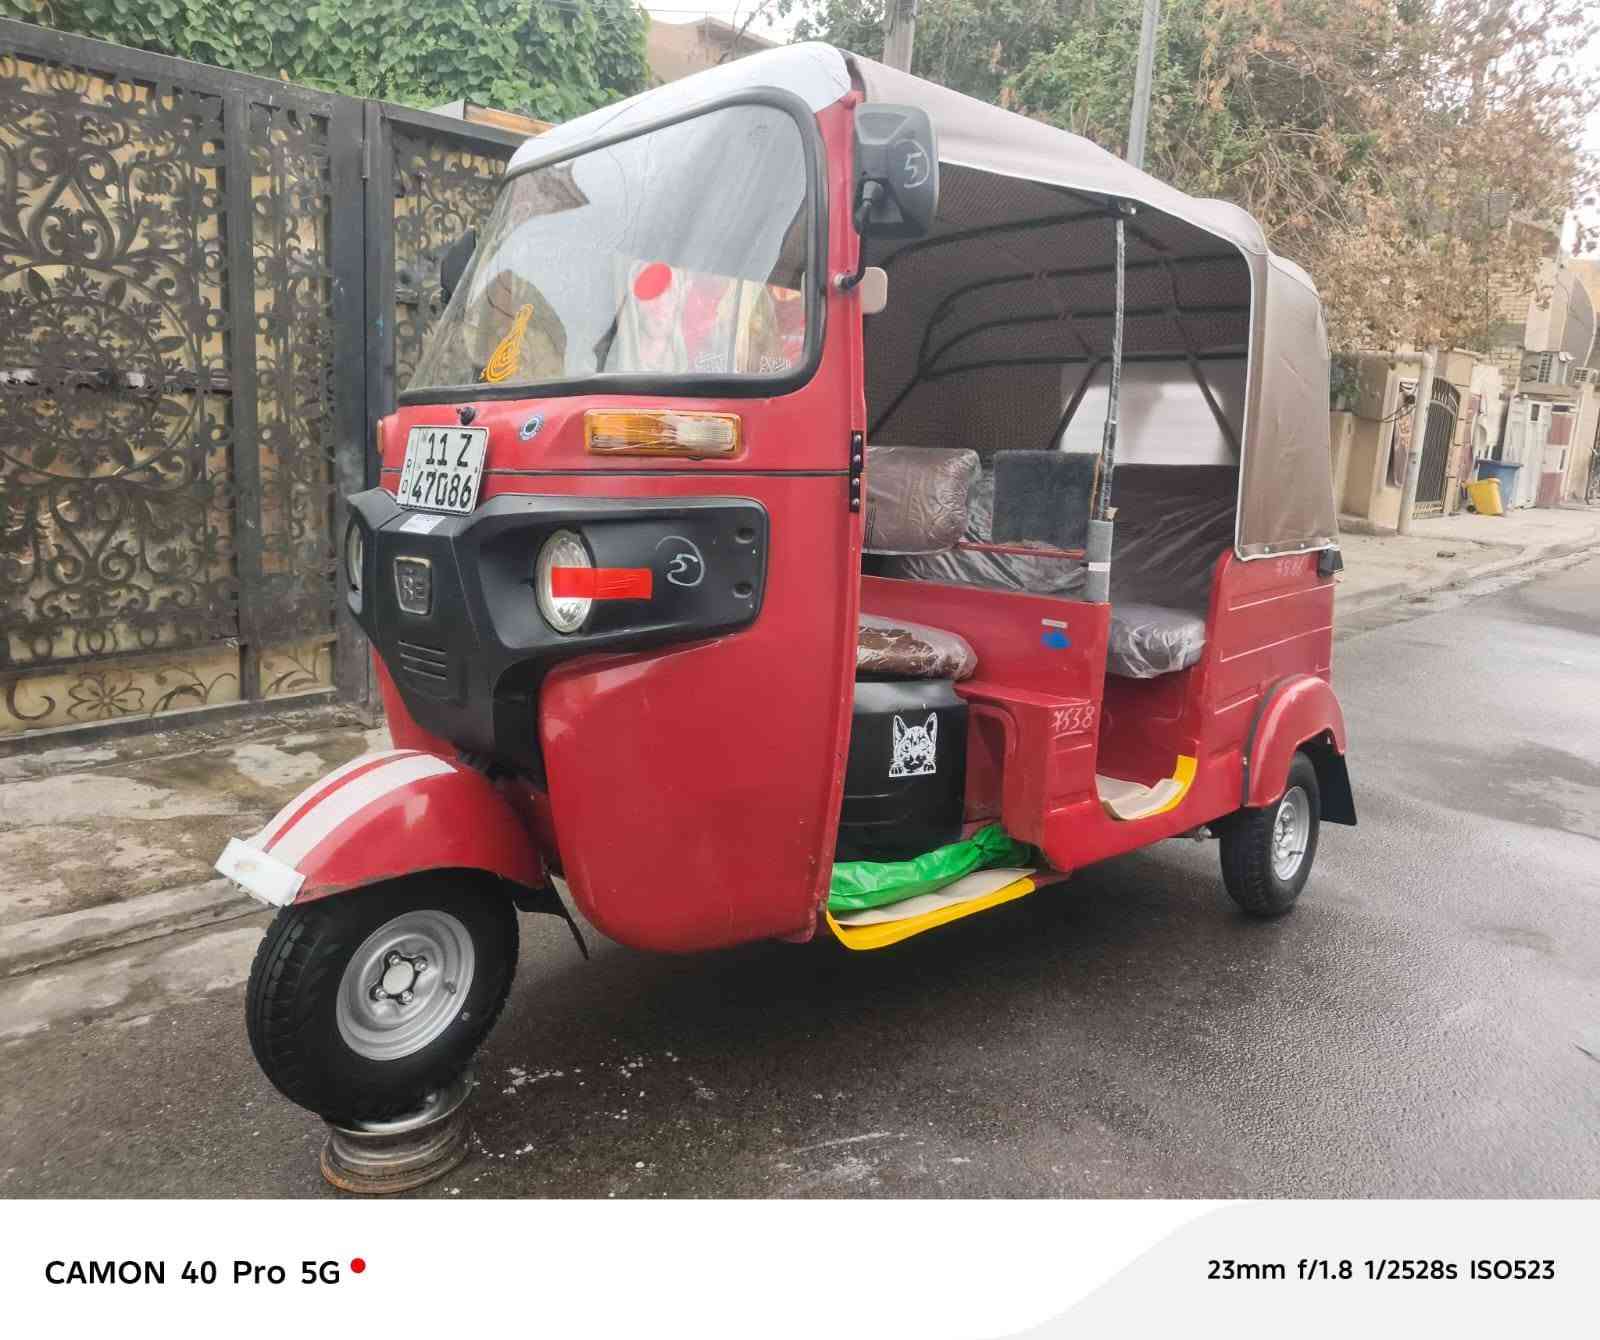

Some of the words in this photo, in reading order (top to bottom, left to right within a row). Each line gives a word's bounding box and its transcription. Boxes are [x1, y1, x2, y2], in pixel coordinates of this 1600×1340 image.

[426, 433, 448, 466] 11
[457, 433, 473, 467] Z
[411, 471, 473, 509] 47086
